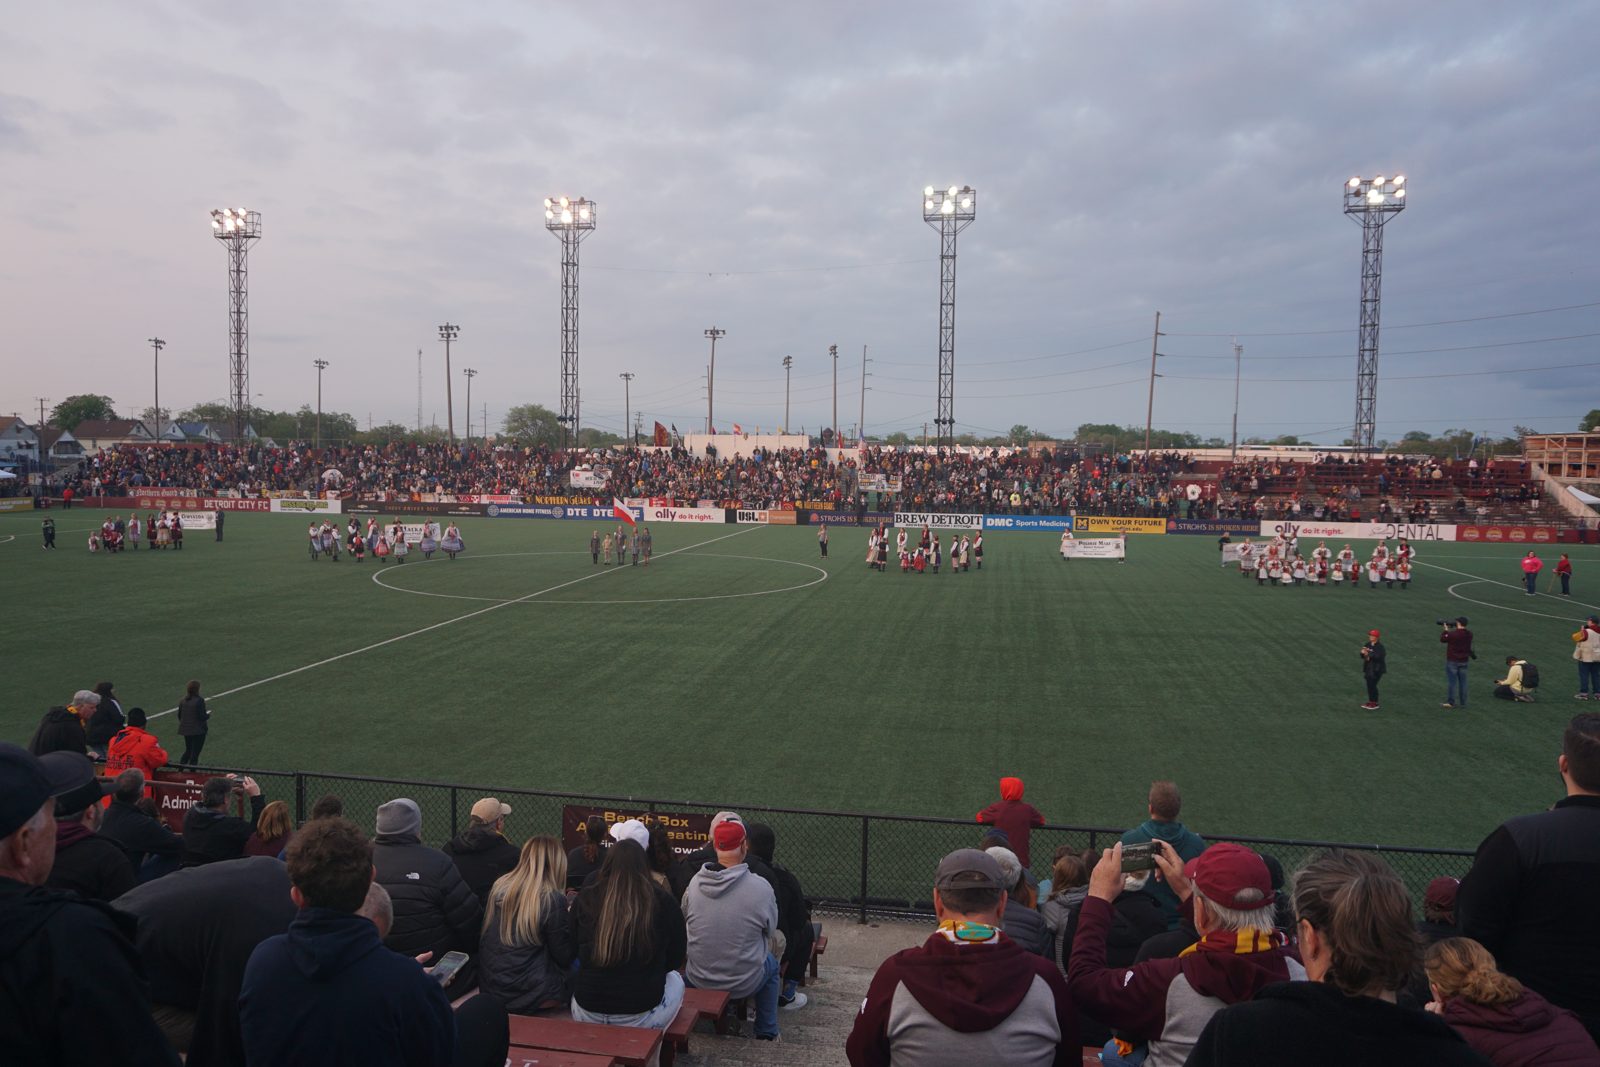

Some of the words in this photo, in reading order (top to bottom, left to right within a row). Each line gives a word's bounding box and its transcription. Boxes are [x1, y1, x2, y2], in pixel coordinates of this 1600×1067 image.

[204, 500, 236, 510] DETROIT
[237, 500, 256, 510] CITY
[257, 501, 269, 510] FC
[567, 508, 588, 517] DTE
[593, 508, 614, 517] DTE
[655, 508, 677, 521] ally
[678, 512, 686, 520] do
[895, 513, 929, 524] BREW
[931, 515, 983, 526] DETROIT
[986, 517, 1014, 527] DMC
[1016, 519, 1038, 528] Sports
[1039, 519, 1070, 528] Medicine
[1090, 518, 1109, 526] OWN
[1111, 519, 1132, 527] YOUR
[1274, 522, 1301, 535] ally
[1302, 527, 1312, 535] do
[1386, 523, 1443, 541] DENTAL
[657, 815, 689, 828] Box
